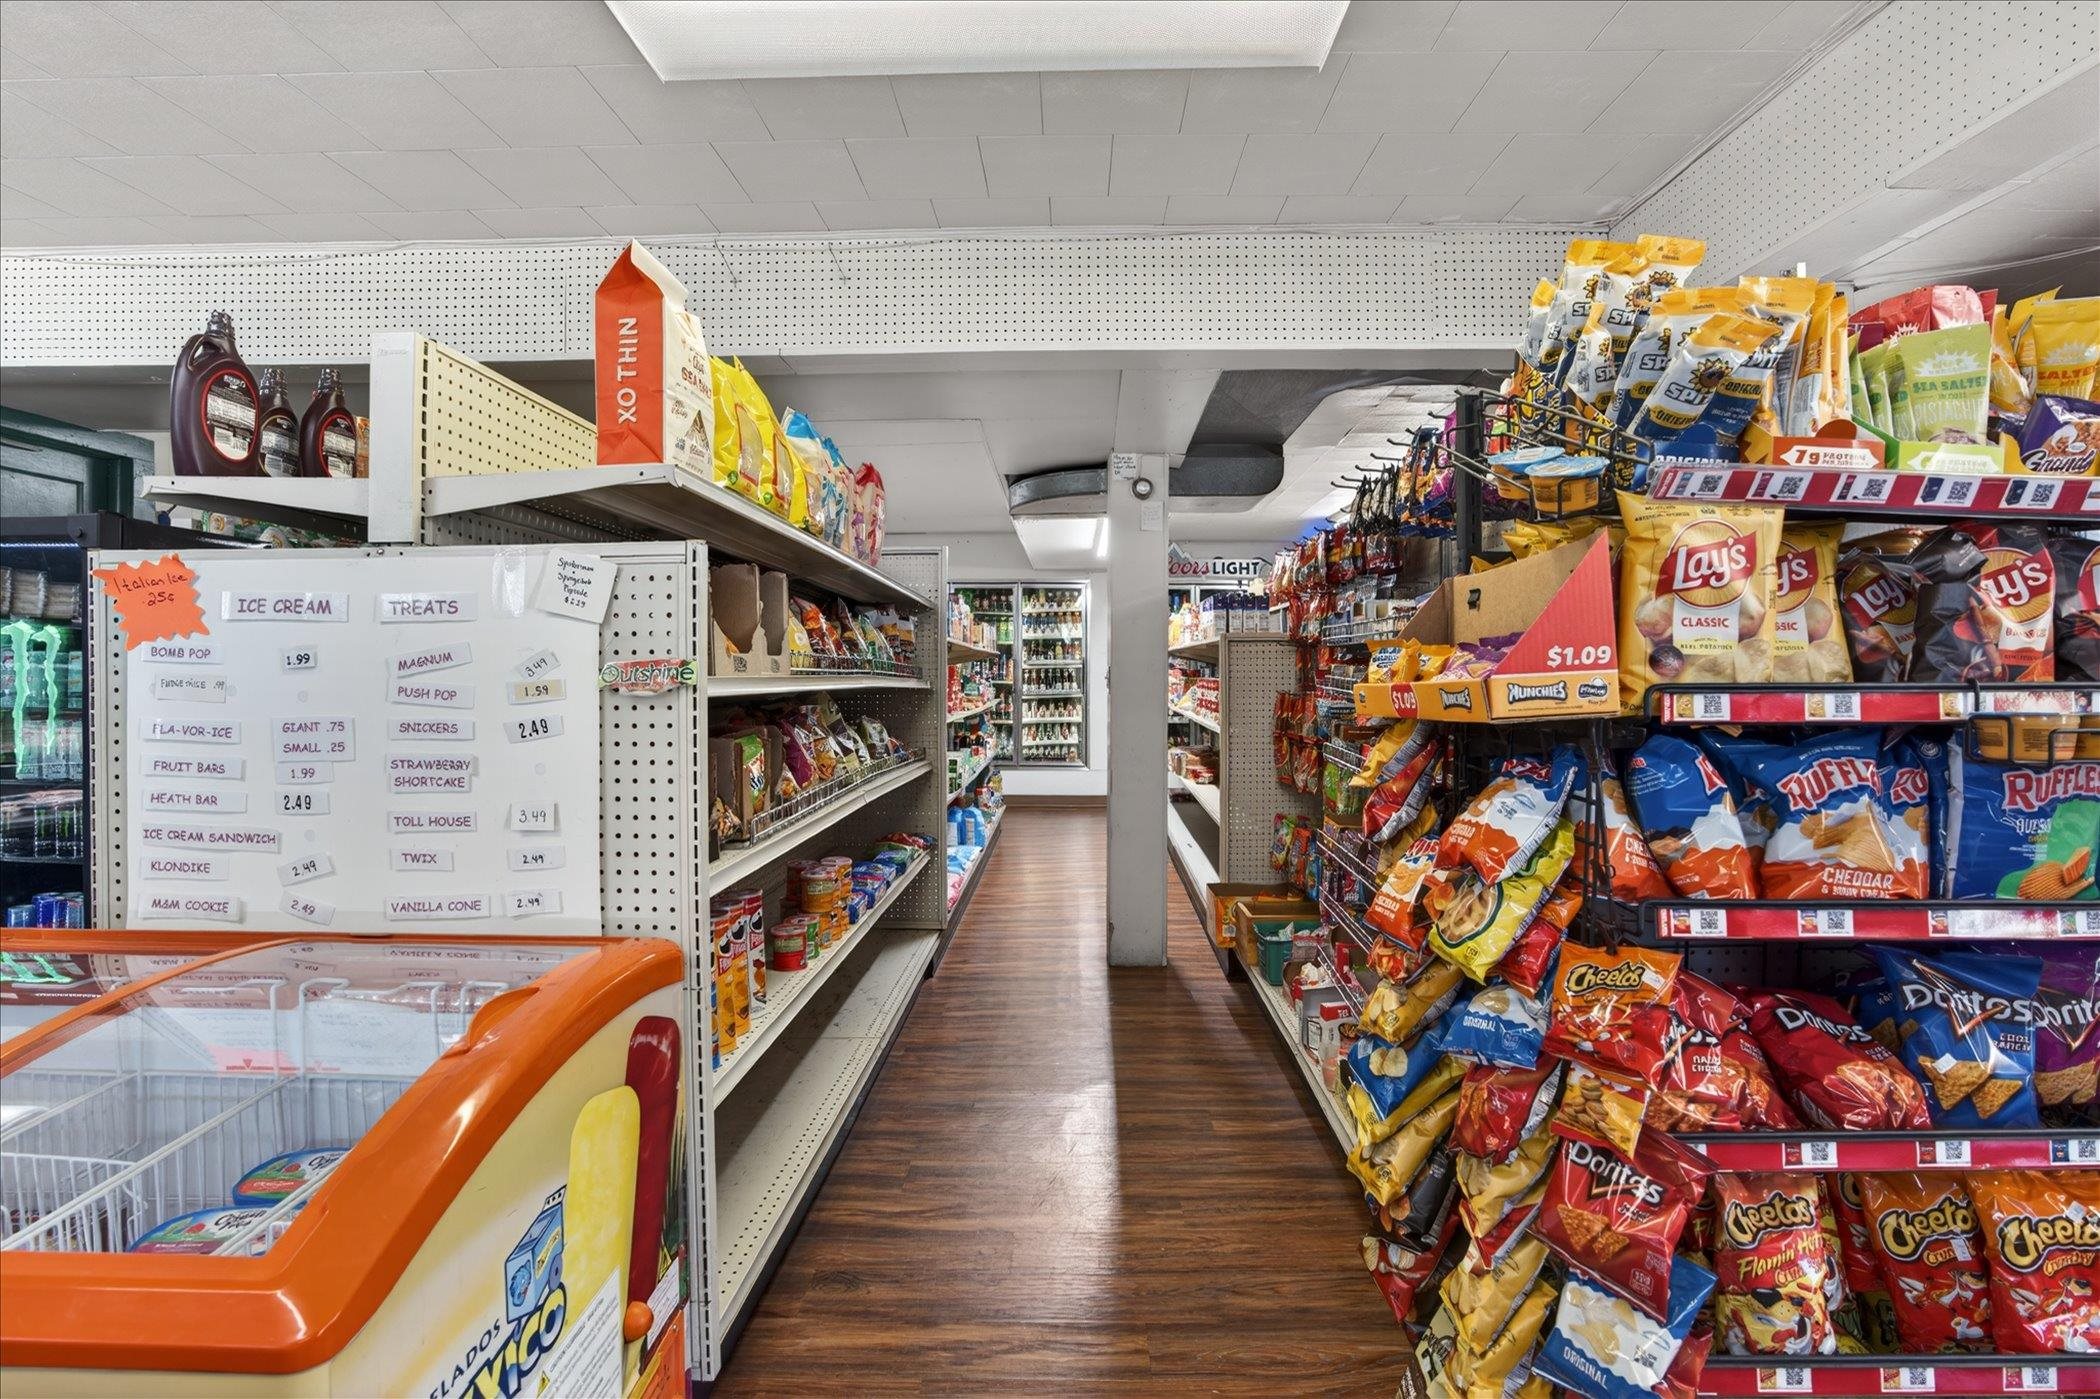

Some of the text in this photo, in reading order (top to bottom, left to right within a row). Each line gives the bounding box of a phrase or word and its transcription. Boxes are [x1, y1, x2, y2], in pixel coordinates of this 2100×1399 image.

[616, 316, 639, 425] XO THIN
[1212, 561, 1260, 575] LIGHT
[1672, 537, 1748, 589] Lay's
[114, 572, 188, 595] Italian Ice
[1776, 553, 1810, 597] y's
[237, 598, 333, 616] ICE CREAM
[387, 600, 460, 616] TREATS
[1680, 616, 1731, 629] CLASSIC
[150, 646, 212, 659] BOMB POP
[285, 652, 312, 666] 1.99
[1546, 645, 1612, 669] $1.09
[397, 651, 455, 672] MAGNUM
[397, 686, 458, 701] PUSH POP
[1392, 690, 1417, 710] $1.09
[1508, 682, 1569, 703] MUNCHIES
[151, 722, 233, 740] FLA-VOR-ICE
[281, 721, 346, 734] GIANT .75
[399, 722, 460, 735] SNICKERS
[281, 742, 346, 754] SMALL .25
[152, 760, 227, 775] FRUIT BARS
[390, 759, 471, 771] STRAWBERRY
[290, 768, 316, 780] 1.99
[393, 776, 467, 789] SHORTCAKE
[2001, 764, 2100, 812] RUFFLE
[149, 792, 219, 806] HEATH BAR
[393, 815, 472, 828] TOLL HOUSE
[143, 828, 278, 845] ICE CREAM SANDWICH
[400, 852, 438, 865] TWIX
[522, 854, 545, 864] 2.49
[149, 860, 211, 875] KLONDIKE
[291, 860, 318, 877] 2.49
[1822, 867, 1895, 890] CHEDDAR
[150, 898, 231, 914] M&M COOKIE
[290, 899, 316, 916] 2.49
[390, 900, 483, 913] VANILLA CONE
[516, 897, 541, 909] 2.49
[1565, 960, 1645, 995] Cheetos
[1902, 984, 2033, 1023] Doritos
[1775, 1007, 1873, 1043] Doritos
[1570, 1140, 1664, 1206] Doritos
[1726, 1192, 1812, 1247] Cheetos
[1880, 1199, 1976, 1257] Cheeto
[2000, 1212, 2100, 1269] Cheeto
[1563, 1346, 1609, 1390] ORIGINAL
